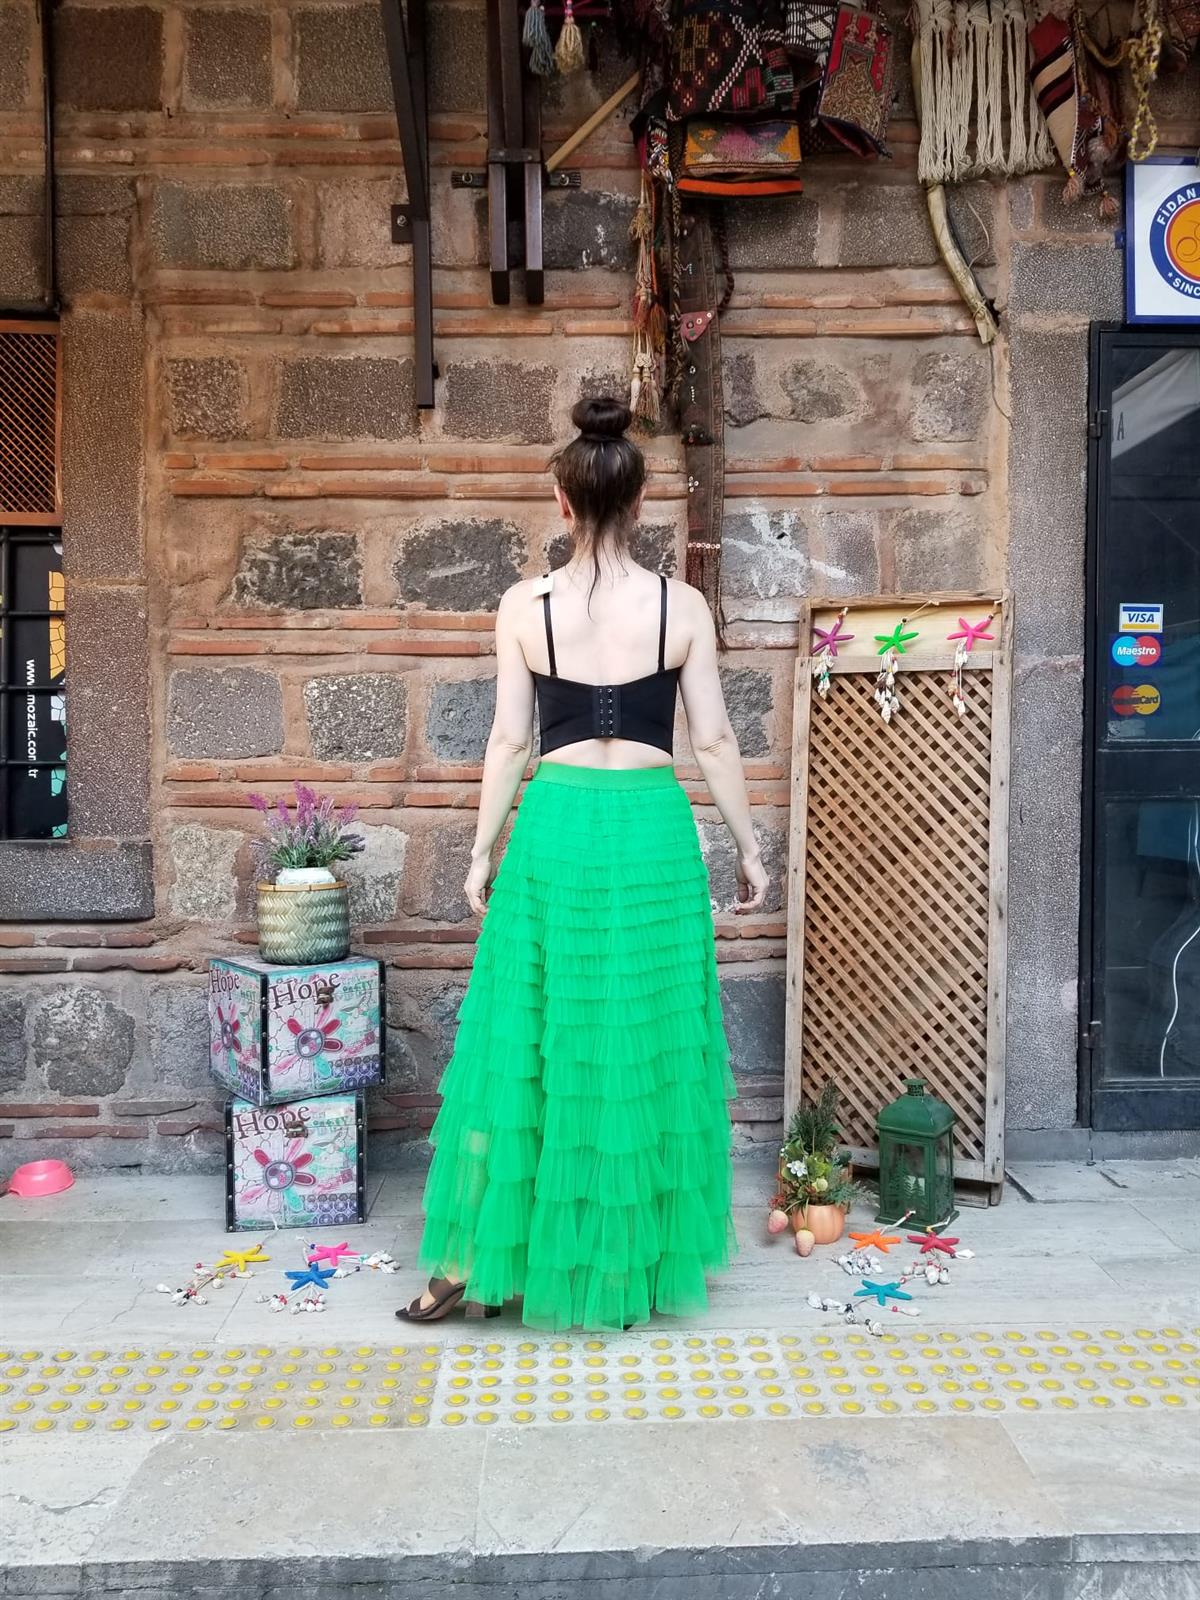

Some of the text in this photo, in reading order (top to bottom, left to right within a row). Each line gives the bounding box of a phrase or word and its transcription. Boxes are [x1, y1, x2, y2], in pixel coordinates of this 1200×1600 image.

[1157, 188, 1197, 225] FİDAN
[1127, 613, 1155, 623] VISA
[1117, 646, 1157, 656] Maestro
[210, 969, 239, 1000] Hope
